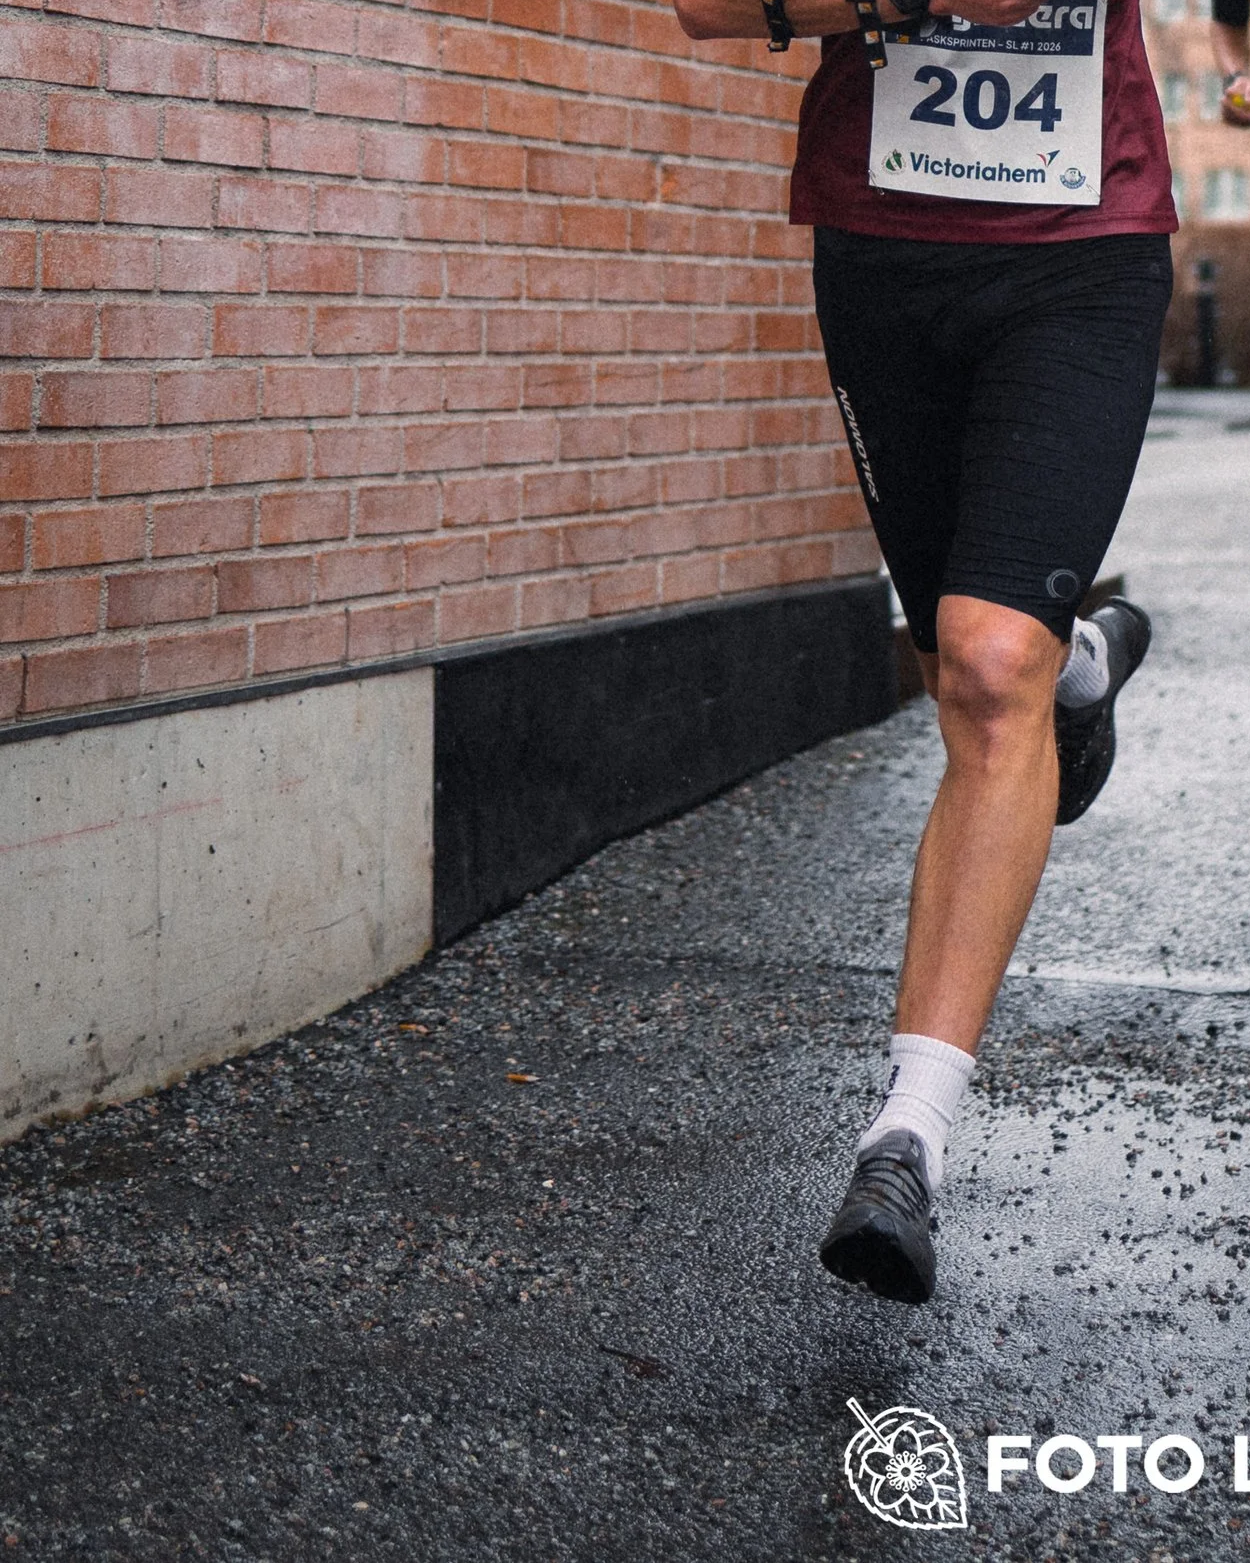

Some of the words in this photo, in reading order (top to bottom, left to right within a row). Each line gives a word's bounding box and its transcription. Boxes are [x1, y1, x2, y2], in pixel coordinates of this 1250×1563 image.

[1006, 40, 1019, 50] SL
[1021, 41, 1034, 51] #1
[1037, 42, 1061, 52] 2026
[909, 64, 1062, 132] 204
[910, 151, 1046, 184] Victoriahem
[837, 386, 880, 503] SALOMON
